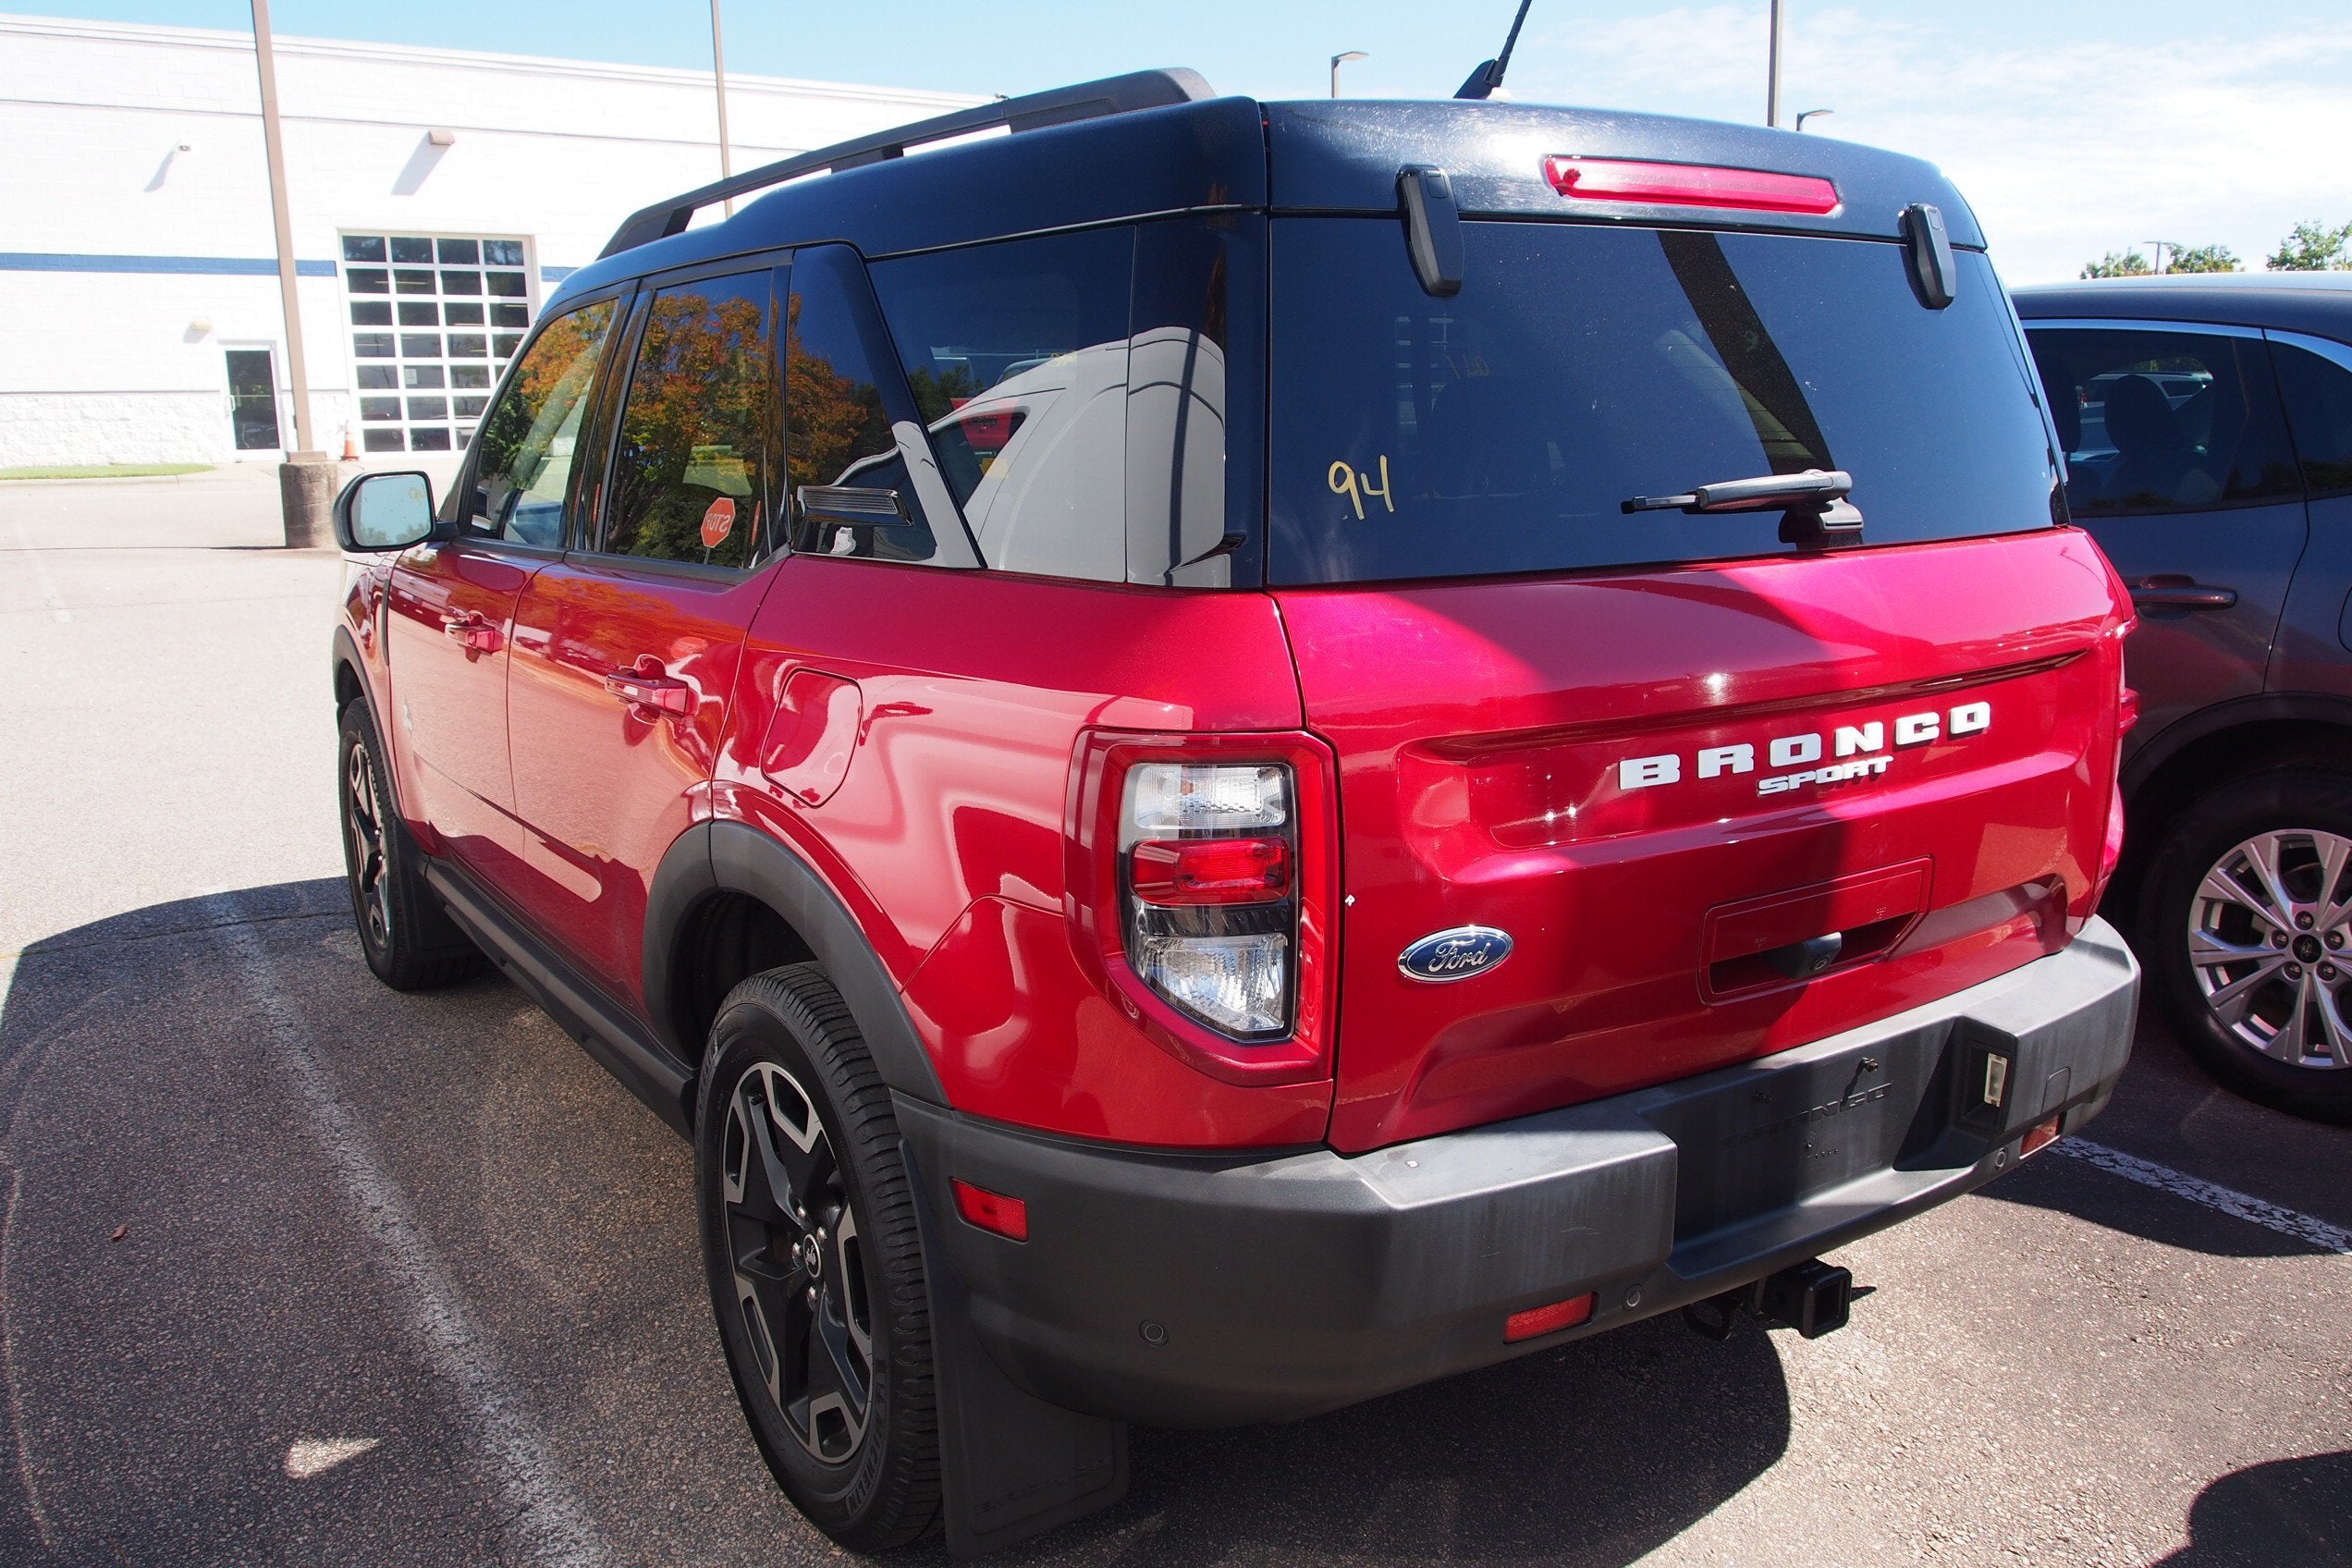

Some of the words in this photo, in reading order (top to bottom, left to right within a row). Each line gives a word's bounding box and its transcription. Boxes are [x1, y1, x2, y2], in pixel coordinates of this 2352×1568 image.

[1329, 455, 1394, 520] 94
[1619, 701, 1991, 790] BRONCO
[1758, 755, 1893, 795] SPORT
[1427, 939, 1491, 972] Ford
